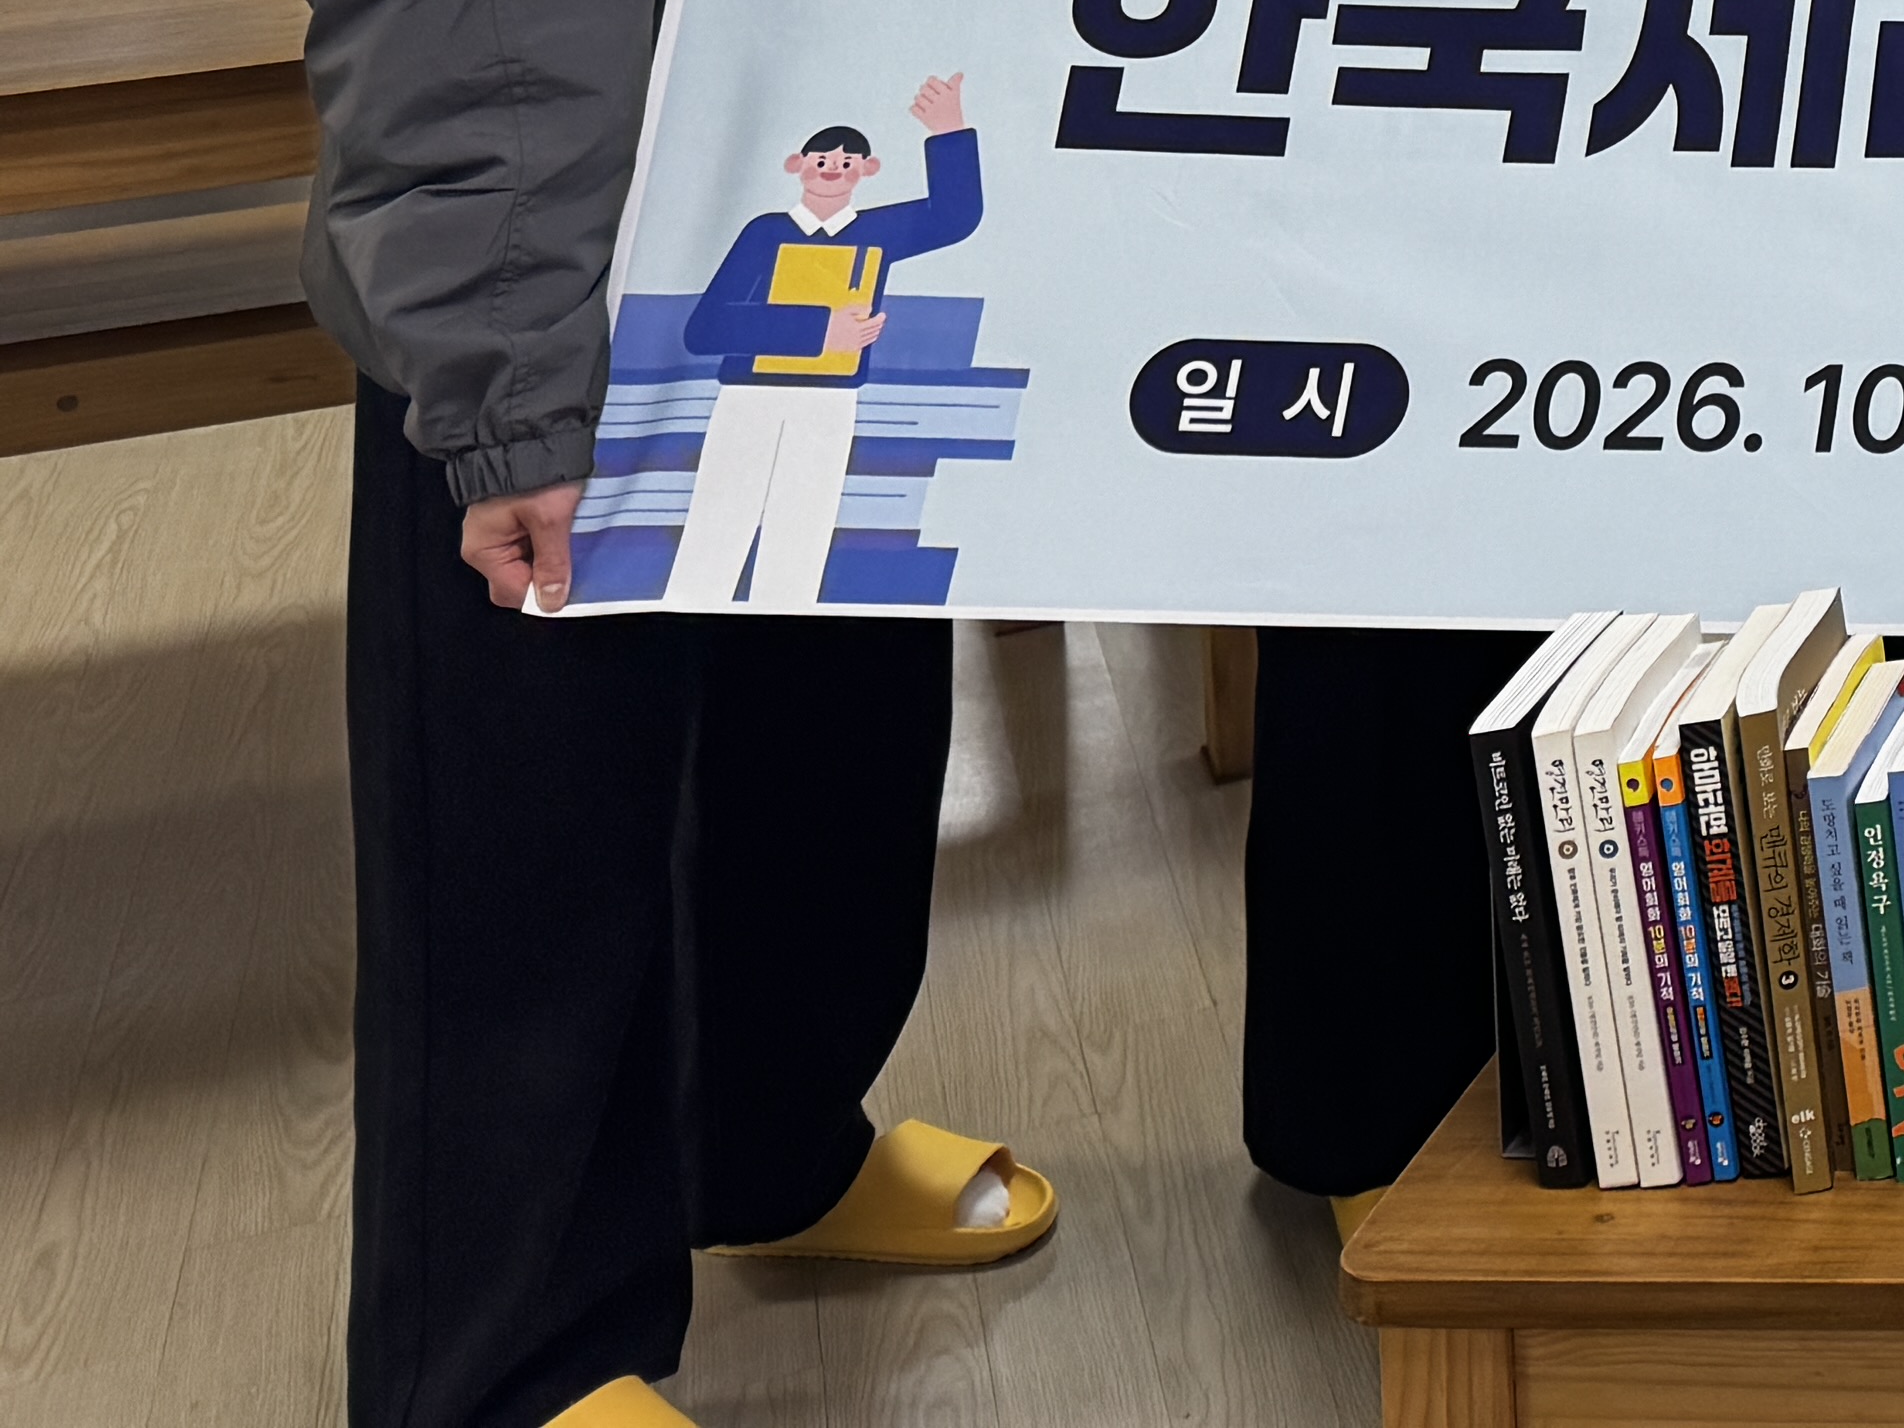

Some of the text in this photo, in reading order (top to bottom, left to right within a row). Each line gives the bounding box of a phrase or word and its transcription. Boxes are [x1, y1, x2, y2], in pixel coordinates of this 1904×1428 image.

[1457, 357, 1763, 453] 2026.
[1488, 750, 1513, 811] 비트코인
[1690, 745, 1730, 837] 하마터면
[1755, 744, 1775, 786] 만화로
[1497, 813, 1517, 844] 없는
[1762, 791, 1777, 820] 보는
[1821, 798, 1843, 857] 도망치고
[1703, 838, 1738, 903] 회계를
[1758, 824, 1791, 894] 맨큐의
[1863, 824, 1892, 915] 인정욕구
[1509, 892, 1530, 924] 없다
[1767, 895, 1801, 965] 경제학
[1656, 971, 1675, 1001] 기적
[1688, 971, 1705, 1001] 기적
[1815, 970, 1832, 999] 기술
